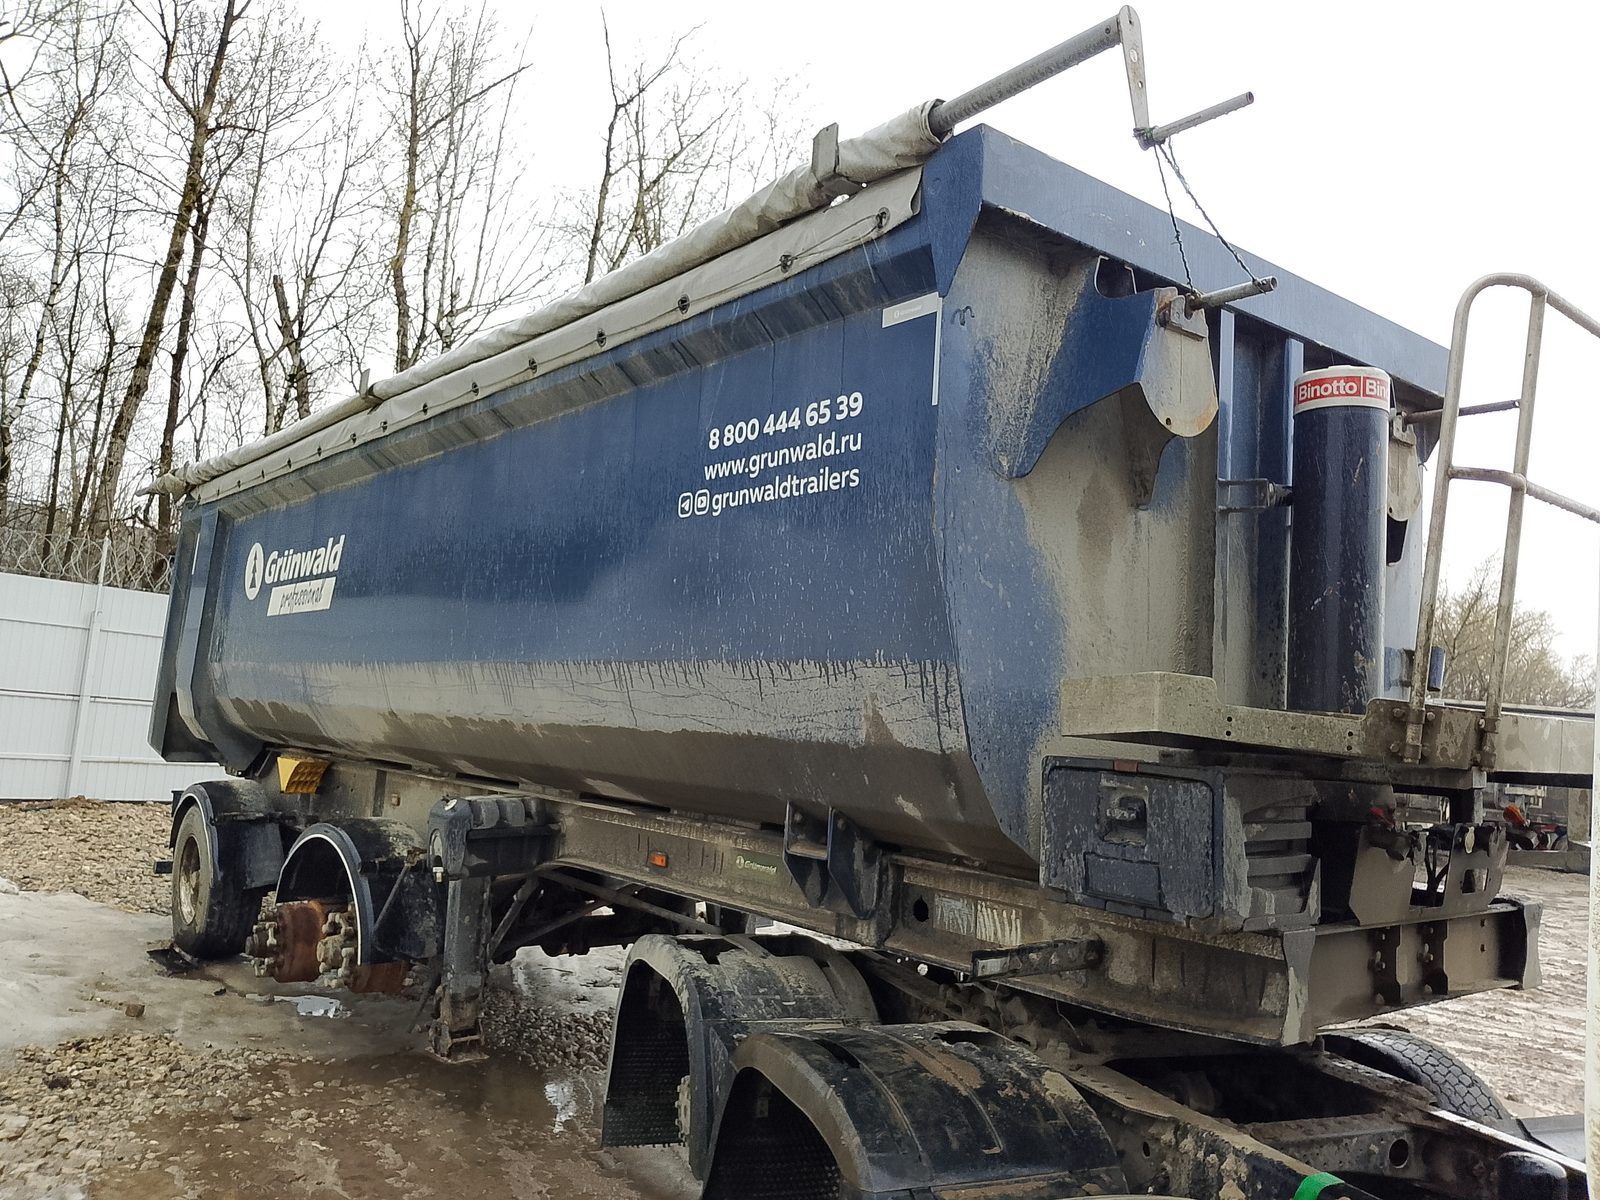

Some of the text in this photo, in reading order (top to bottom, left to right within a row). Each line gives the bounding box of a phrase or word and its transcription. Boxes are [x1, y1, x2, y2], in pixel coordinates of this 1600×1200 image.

[1298, 379, 1389, 401] Binotto Bin
[708, 391, 864, 450] 8 800 444 65 39
[704, 431, 862, 480] www.grunwald.ru
[711, 466, 860, 516] grunwaldtrailers
[264, 534, 346, 585] Grünwald
